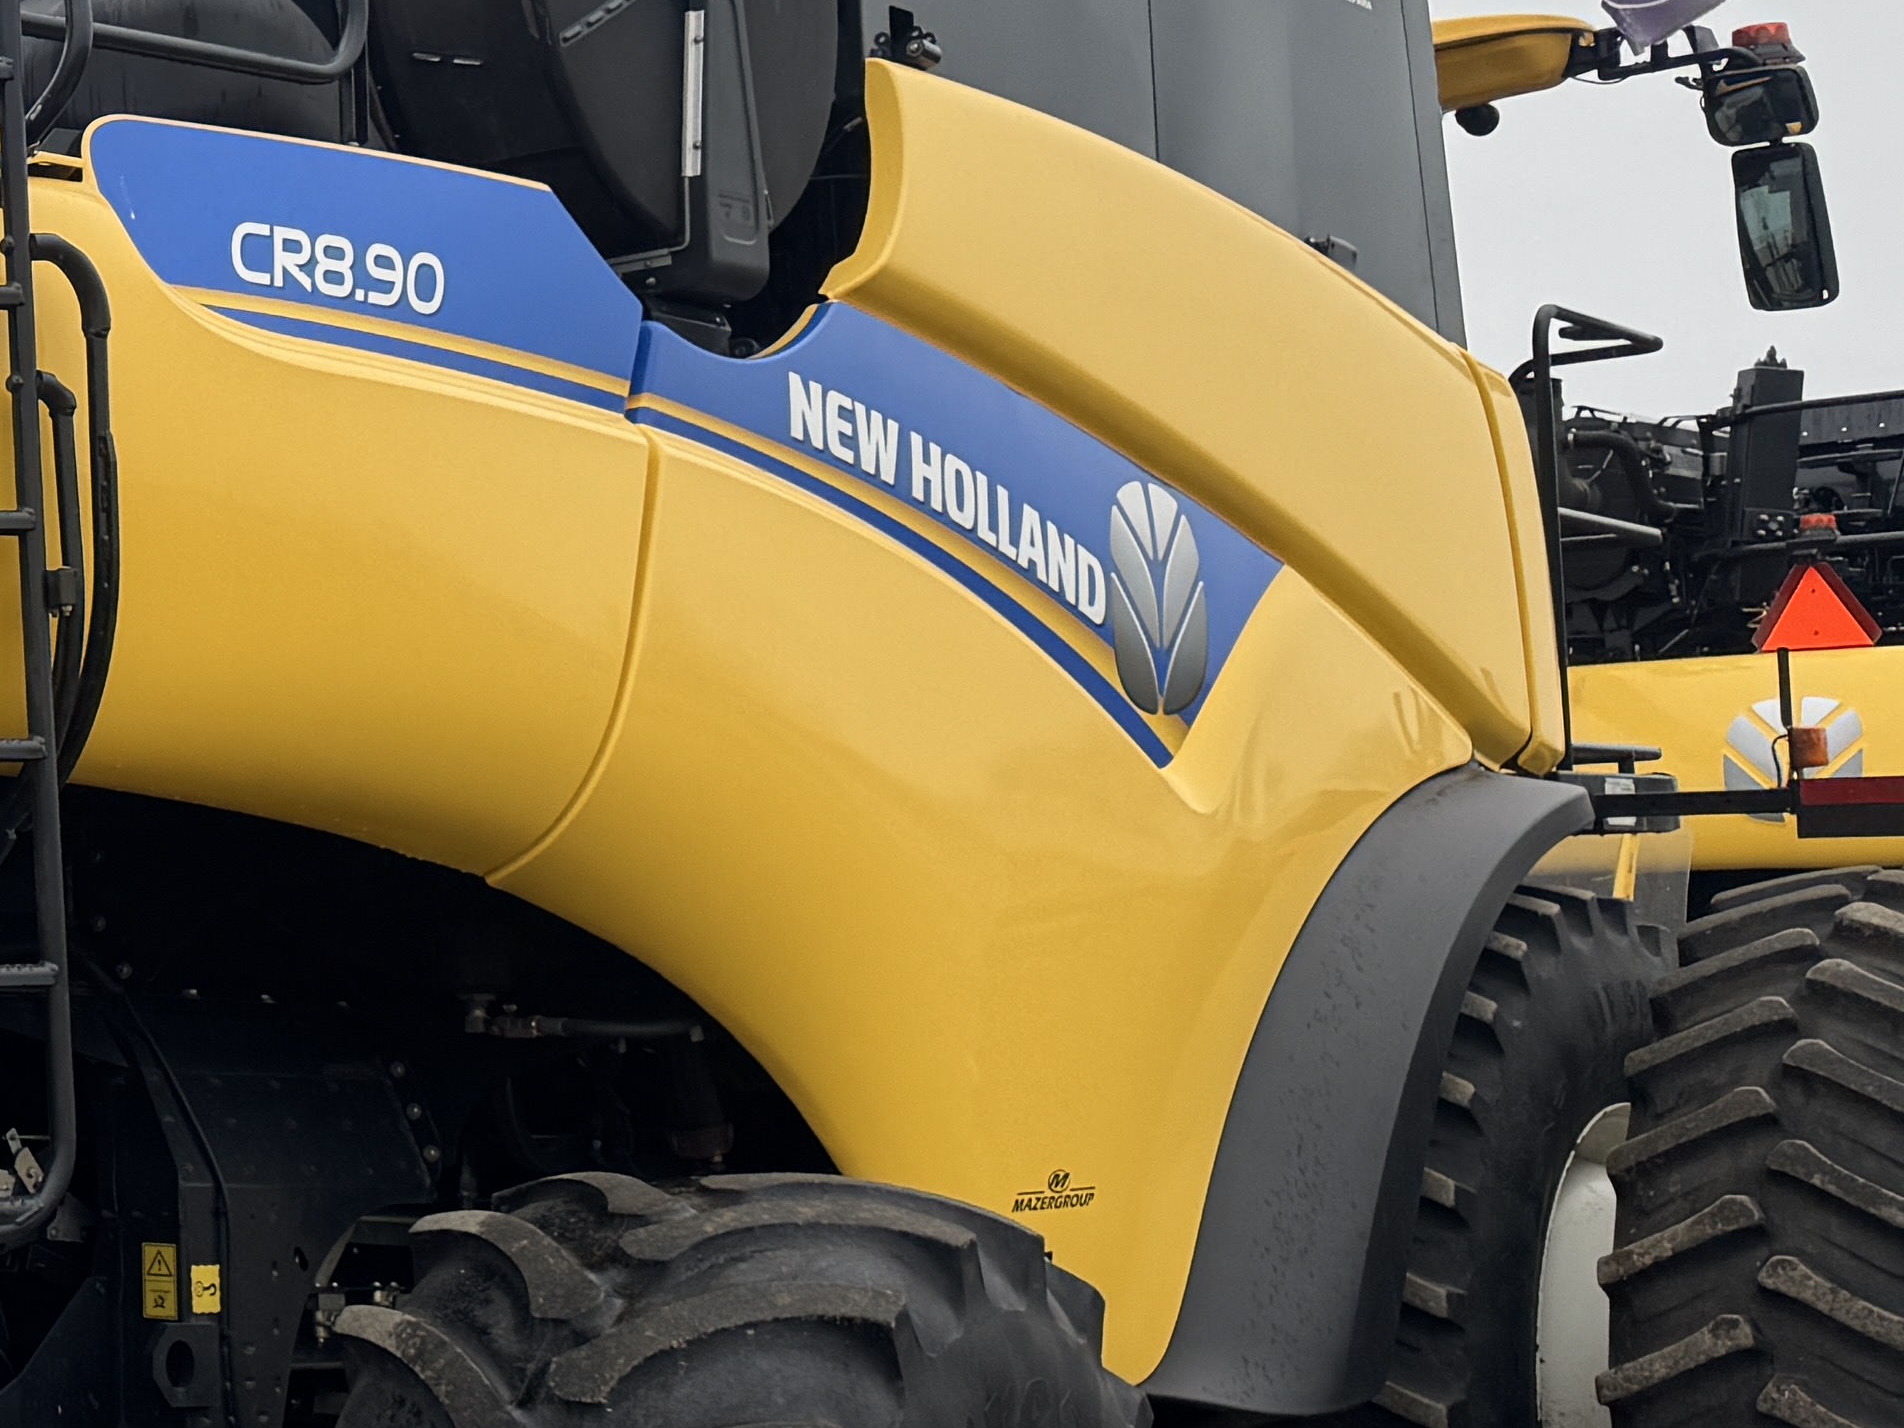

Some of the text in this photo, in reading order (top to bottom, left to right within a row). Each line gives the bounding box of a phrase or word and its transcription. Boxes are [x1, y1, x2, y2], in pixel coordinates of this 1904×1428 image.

[231, 221, 446, 315] CR8.90
[788, 371, 1109, 628] NEW HOLLAND
[1012, 1193, 1095, 1212] MAZERGROUP
